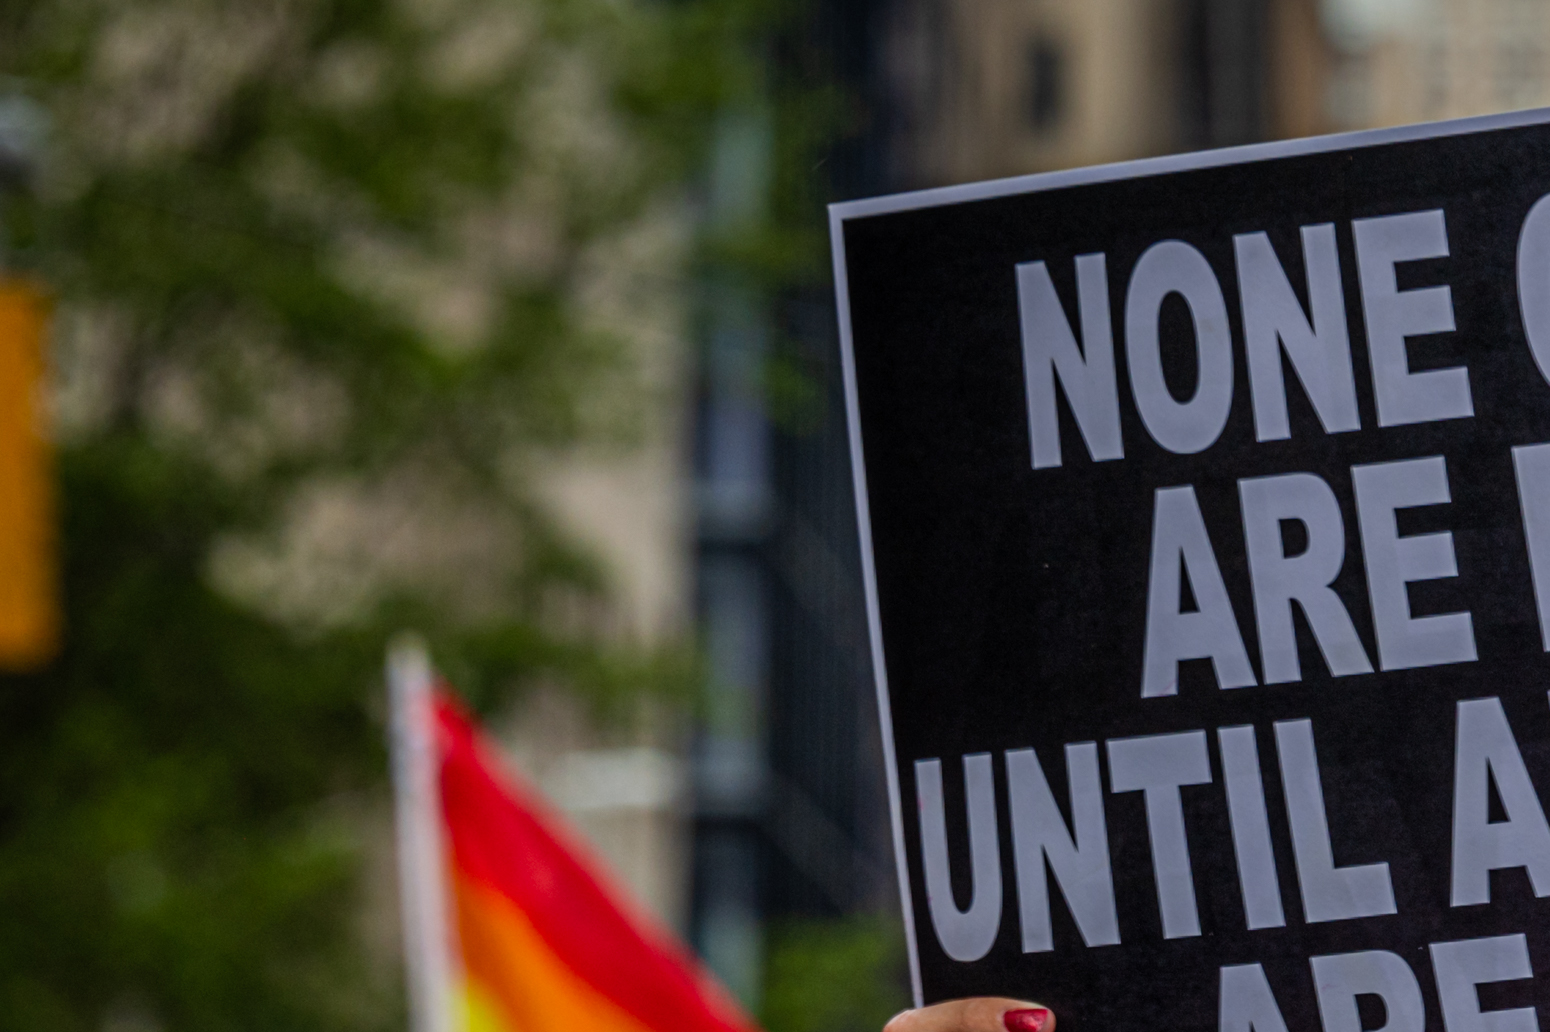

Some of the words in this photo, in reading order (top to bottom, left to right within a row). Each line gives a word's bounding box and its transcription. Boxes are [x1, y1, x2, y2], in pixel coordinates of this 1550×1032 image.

[1016, 209, 1474, 469] NONE
[1141, 456, 1478, 698] ARE
[915, 719, 1397, 961] UNTIL
